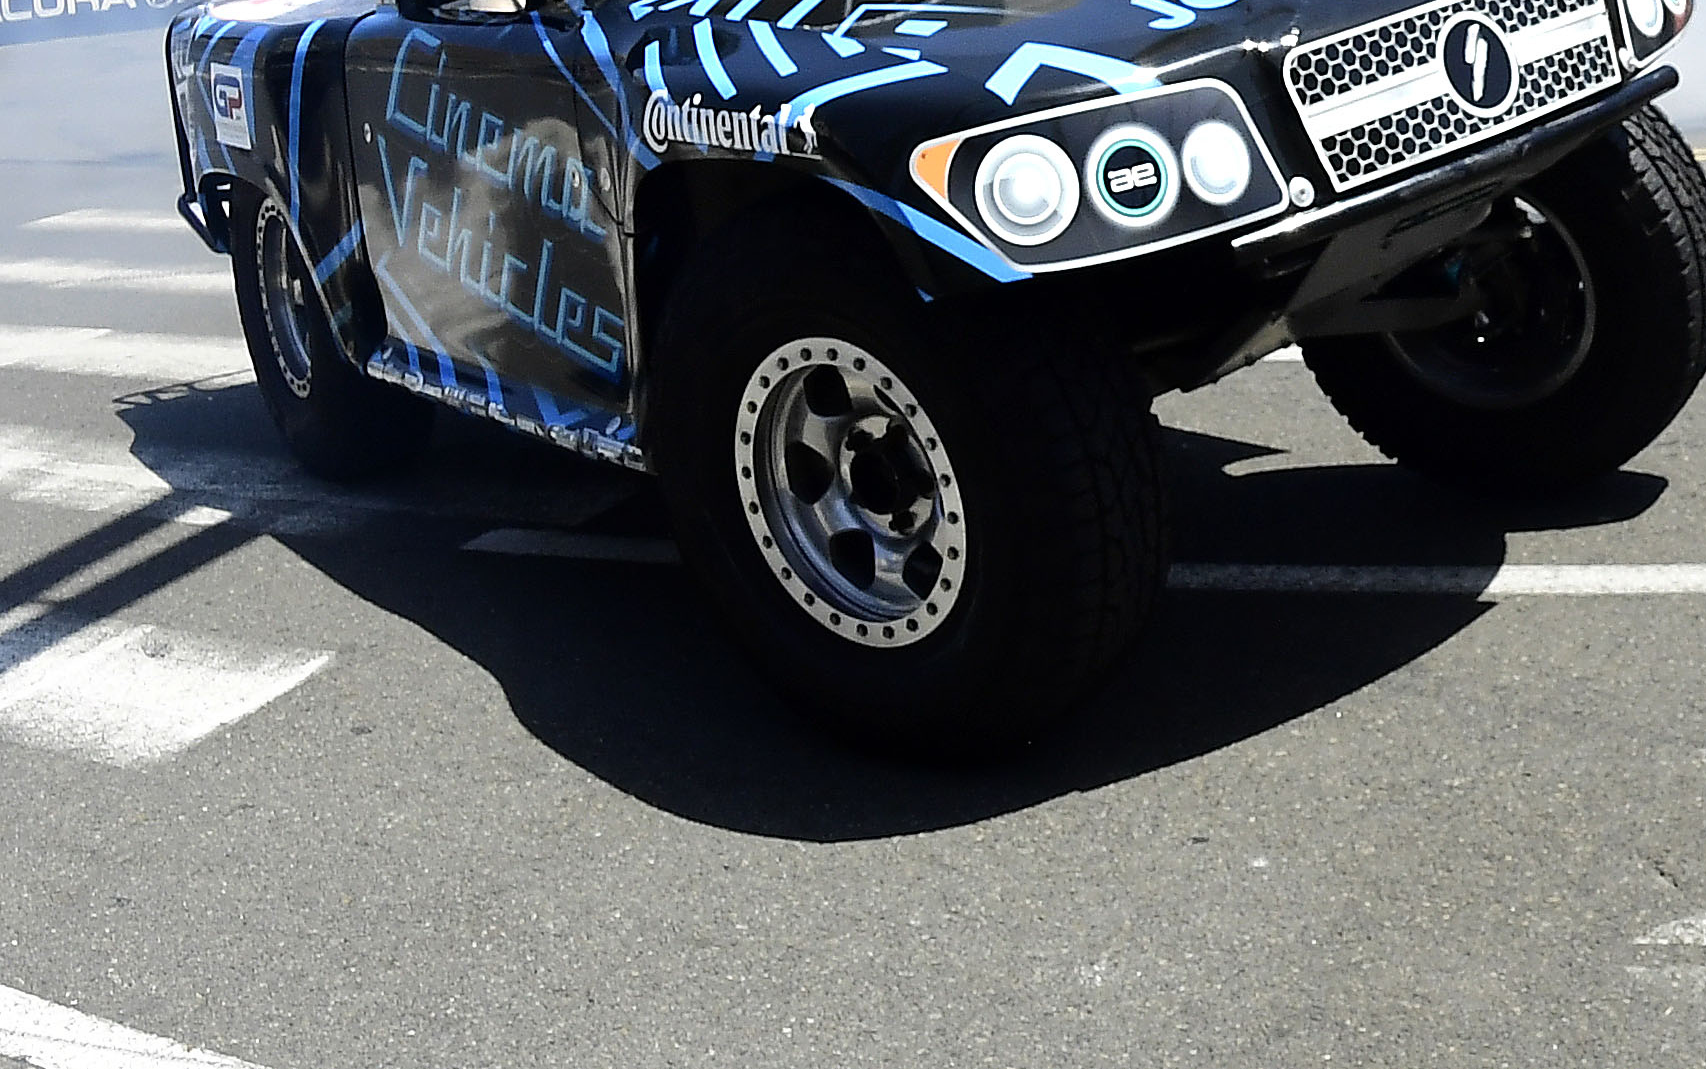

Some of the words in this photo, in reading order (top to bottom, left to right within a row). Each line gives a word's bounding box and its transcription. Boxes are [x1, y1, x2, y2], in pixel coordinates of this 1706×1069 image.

[386, 27, 608, 242] Cinema
[643, 88, 791, 154] Continental
[377, 133, 627, 376] Vehicles
